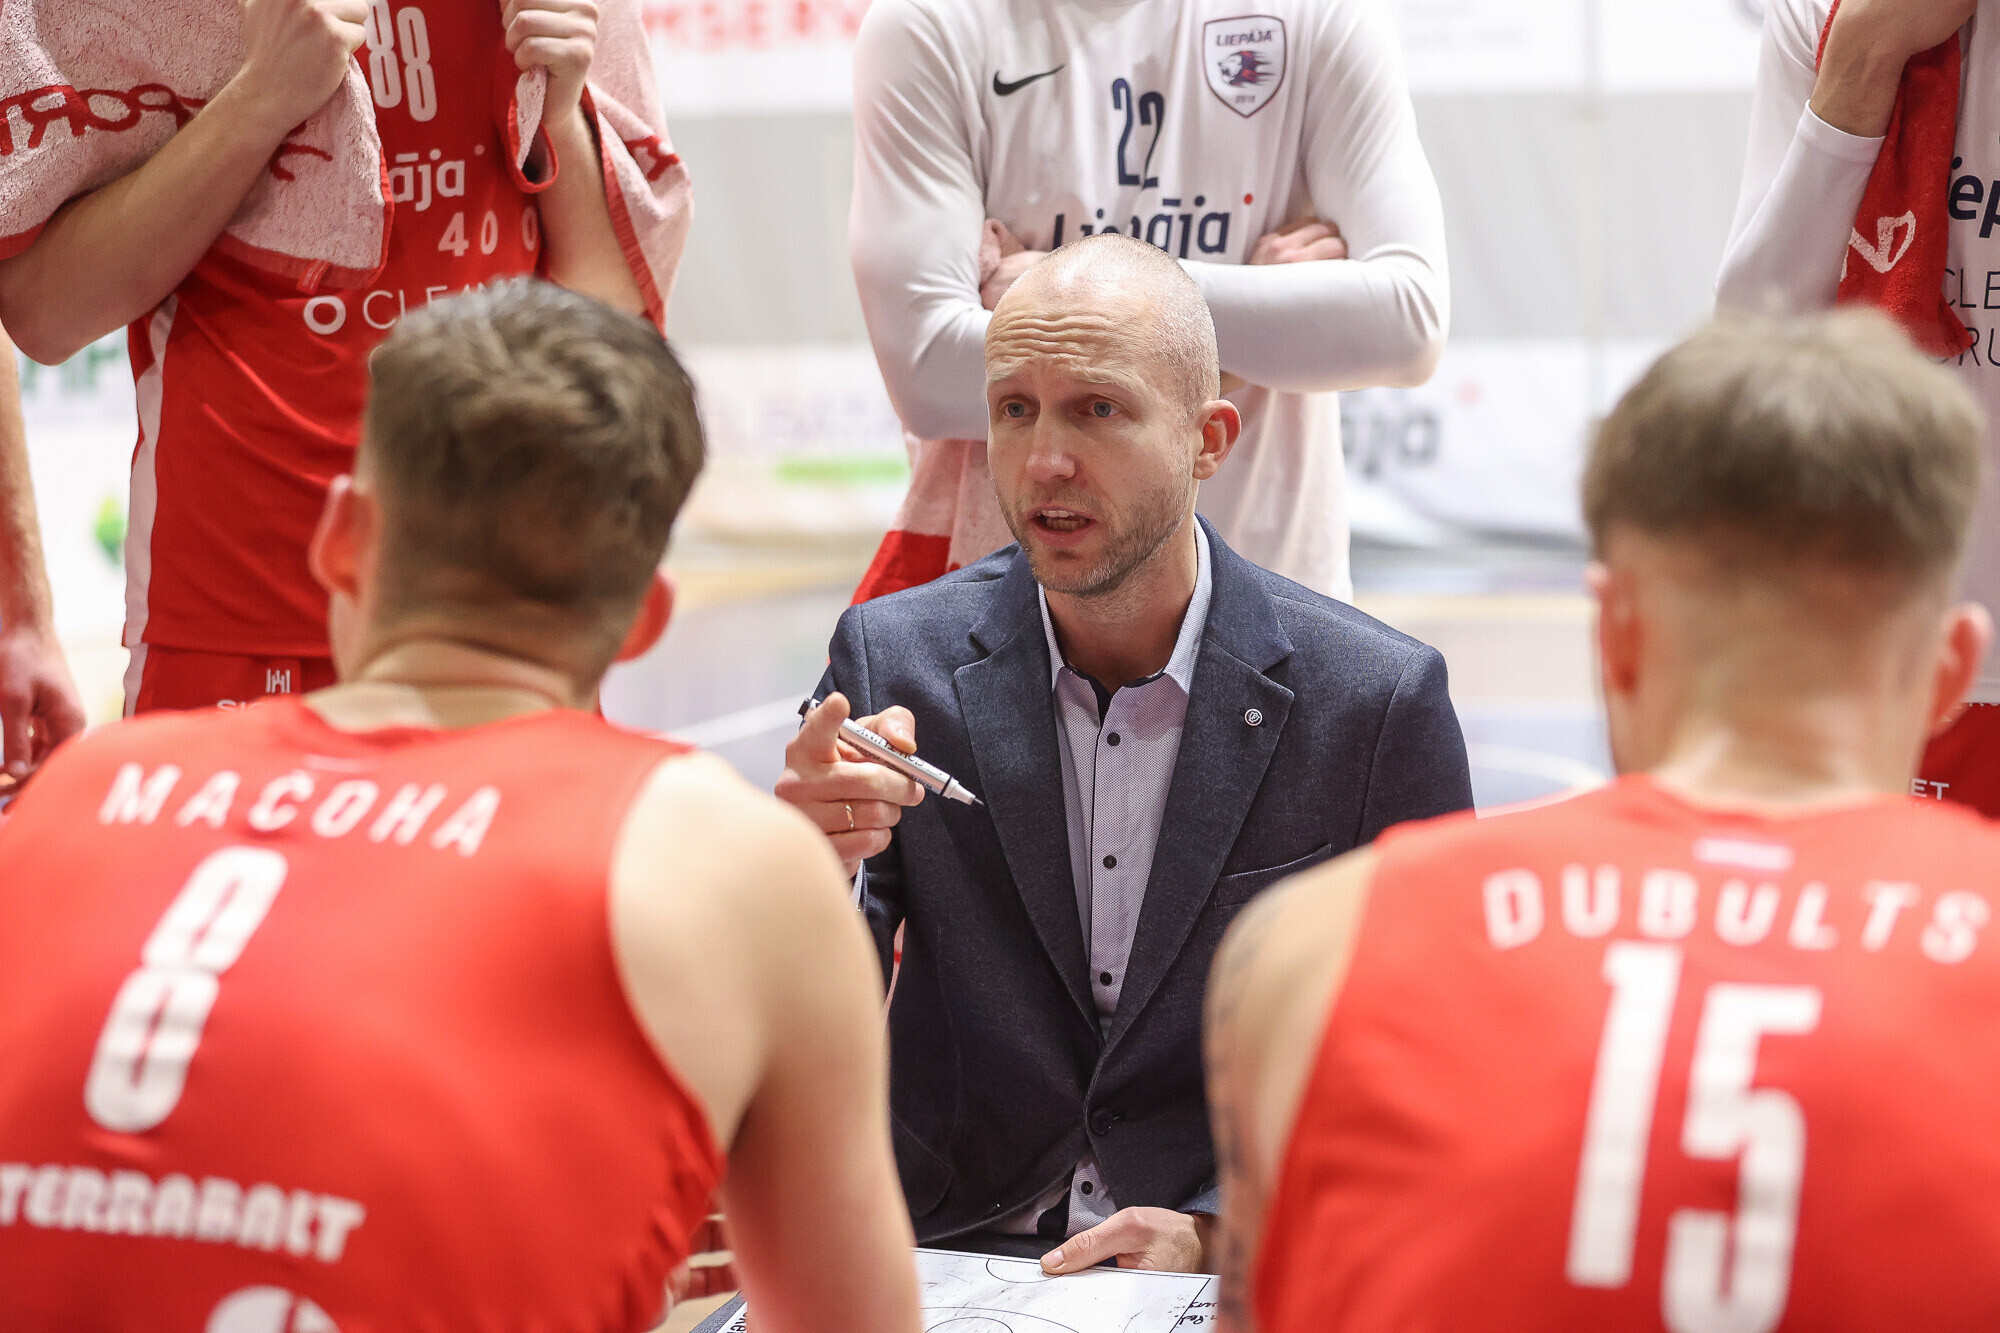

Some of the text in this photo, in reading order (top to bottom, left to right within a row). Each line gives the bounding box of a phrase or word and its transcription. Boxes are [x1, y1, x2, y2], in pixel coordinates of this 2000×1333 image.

[364, 0, 438, 121] 88
[1112, 78, 1165, 190] 22
[1481, 861, 1993, 965] DUBULTS
[84, 845, 289, 1133] 8
[1563, 939, 1825, 1333] 15
